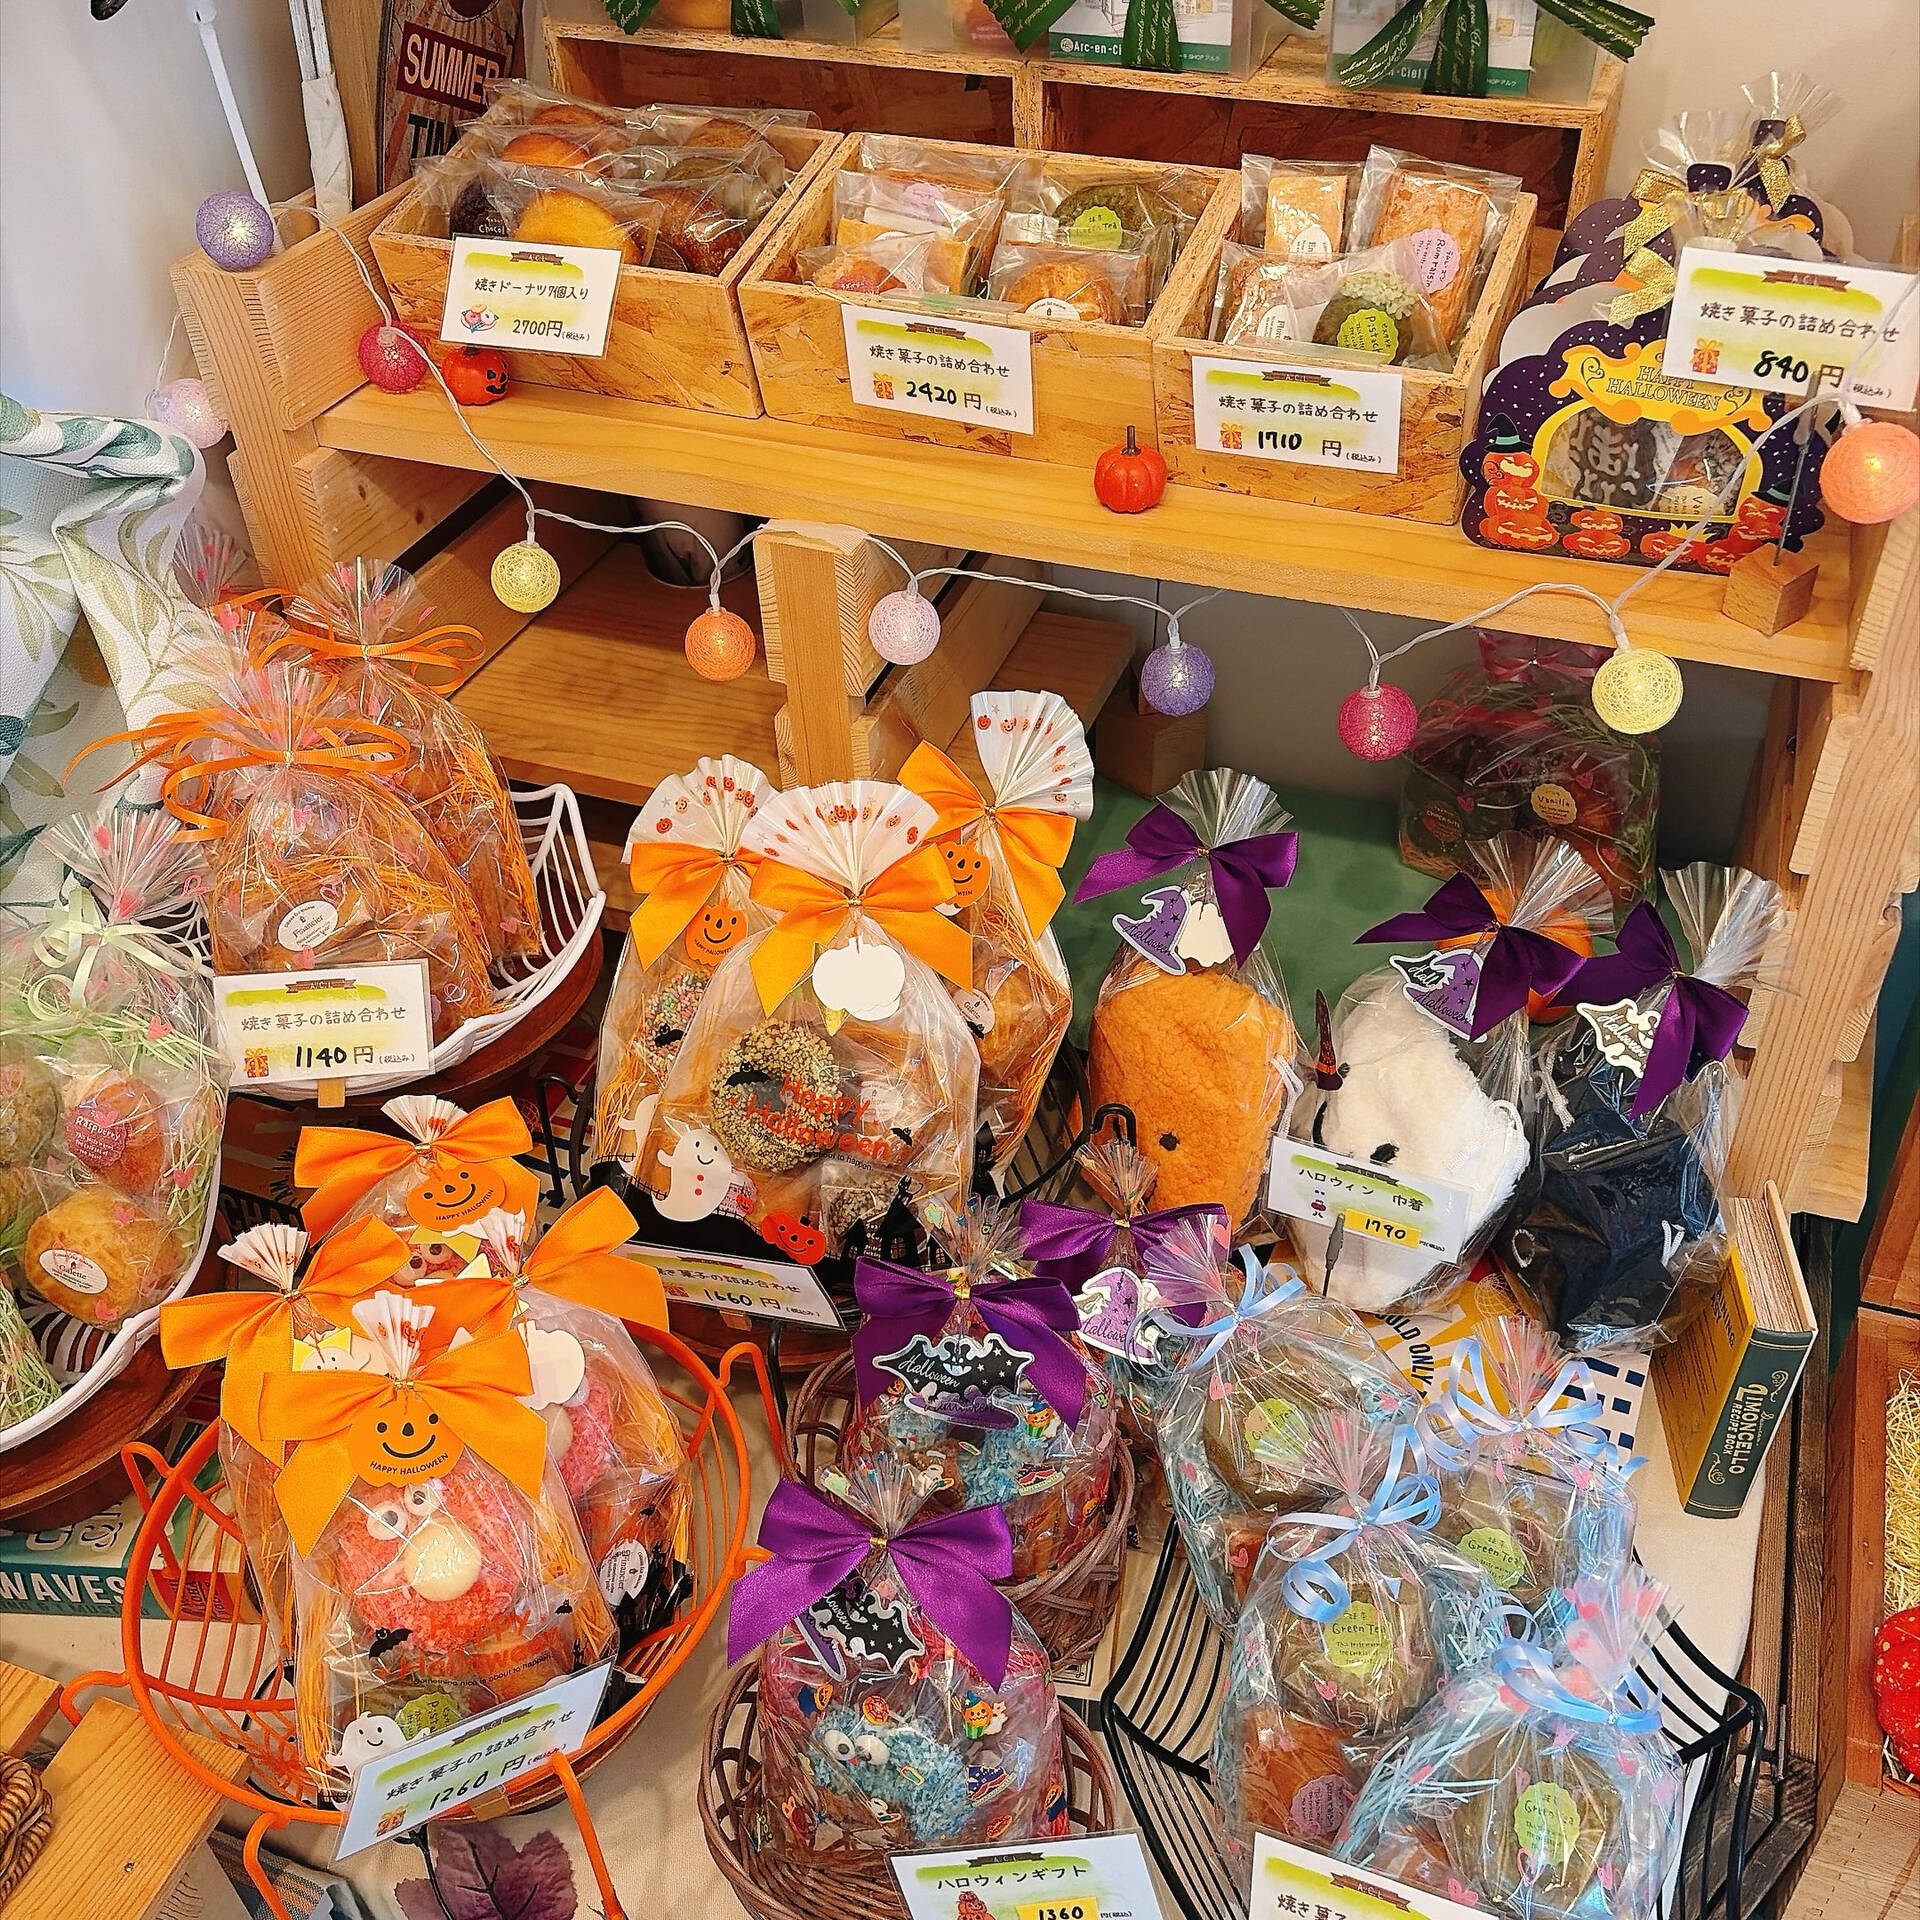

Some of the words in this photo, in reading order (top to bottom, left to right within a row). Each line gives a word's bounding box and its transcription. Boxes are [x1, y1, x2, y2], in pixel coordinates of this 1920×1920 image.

[1073, 42, 1122, 57] Arc-en-Ci
[1430, 237, 1446, 260] Rum
[1424, 260, 1440, 288] raisin
[474, 277, 589, 300] 焼きドーナツ7個入り
[869, 344, 1011, 379] 焼き菓子の詰め合わせ
[1753, 350, 1809, 384] 840
[1819, 364, 1846, 388] 円
[905, 381, 958, 405] 2420
[963, 392, 982, 411] 円
[1605, 377, 1722, 412] HALLOWEEN
[1218, 395, 1379, 423] 焼き菓子の詰め合わせ
[1257, 430, 1303, 451] 1710
[1321, 439, 1342, 458] 円
[1121, 923, 1174, 957] Halloween
[241, 1007, 407, 1032] 焼き菓子の詰め合わせ
[295, 1046, 347, 1068] 1140
[353, 1045, 374, 1065] 円
[780, 1069, 871, 1126] Happy
[75, 1115, 121, 1141] Raspberry
[745, 1093, 890, 1161] Halloween
[435, 1212, 460, 1221] HAPPY
[461, 1189, 495, 1217] HALLOWEEN
[1392, 1194, 1424, 1212] 巾着
[1364, 1217, 1407, 1240] 1790
[703, 1288, 753, 1307] 1660
[760, 1297, 781, 1310] 円
[898, 1353, 961, 1388] Halloween
[1409, 1343, 1435, 1386] ONLY
[1728, 1402, 1743, 1433] RECIPE
[1728, 1383, 1769, 1475] LIMONCELLO
[1722, 1433, 1737, 1456] BOOK
[369, 1460, 399, 1475] HAPPY
[399, 1452, 449, 1475] HALLOWEEN
[1468, 1539, 1500, 1557] Green
[0, 1571, 125, 1605] WAVES
[1332, 1622, 1365, 1635] Green
[488, 1669, 512, 1683] about
[386, 1710, 576, 1800] 焼き菓子の詰め合わせ
[429, 1770, 489, 1810] 1260
[500, 1754, 527, 1777] 円
[1038, 1905, 1084, 1920] 1360
